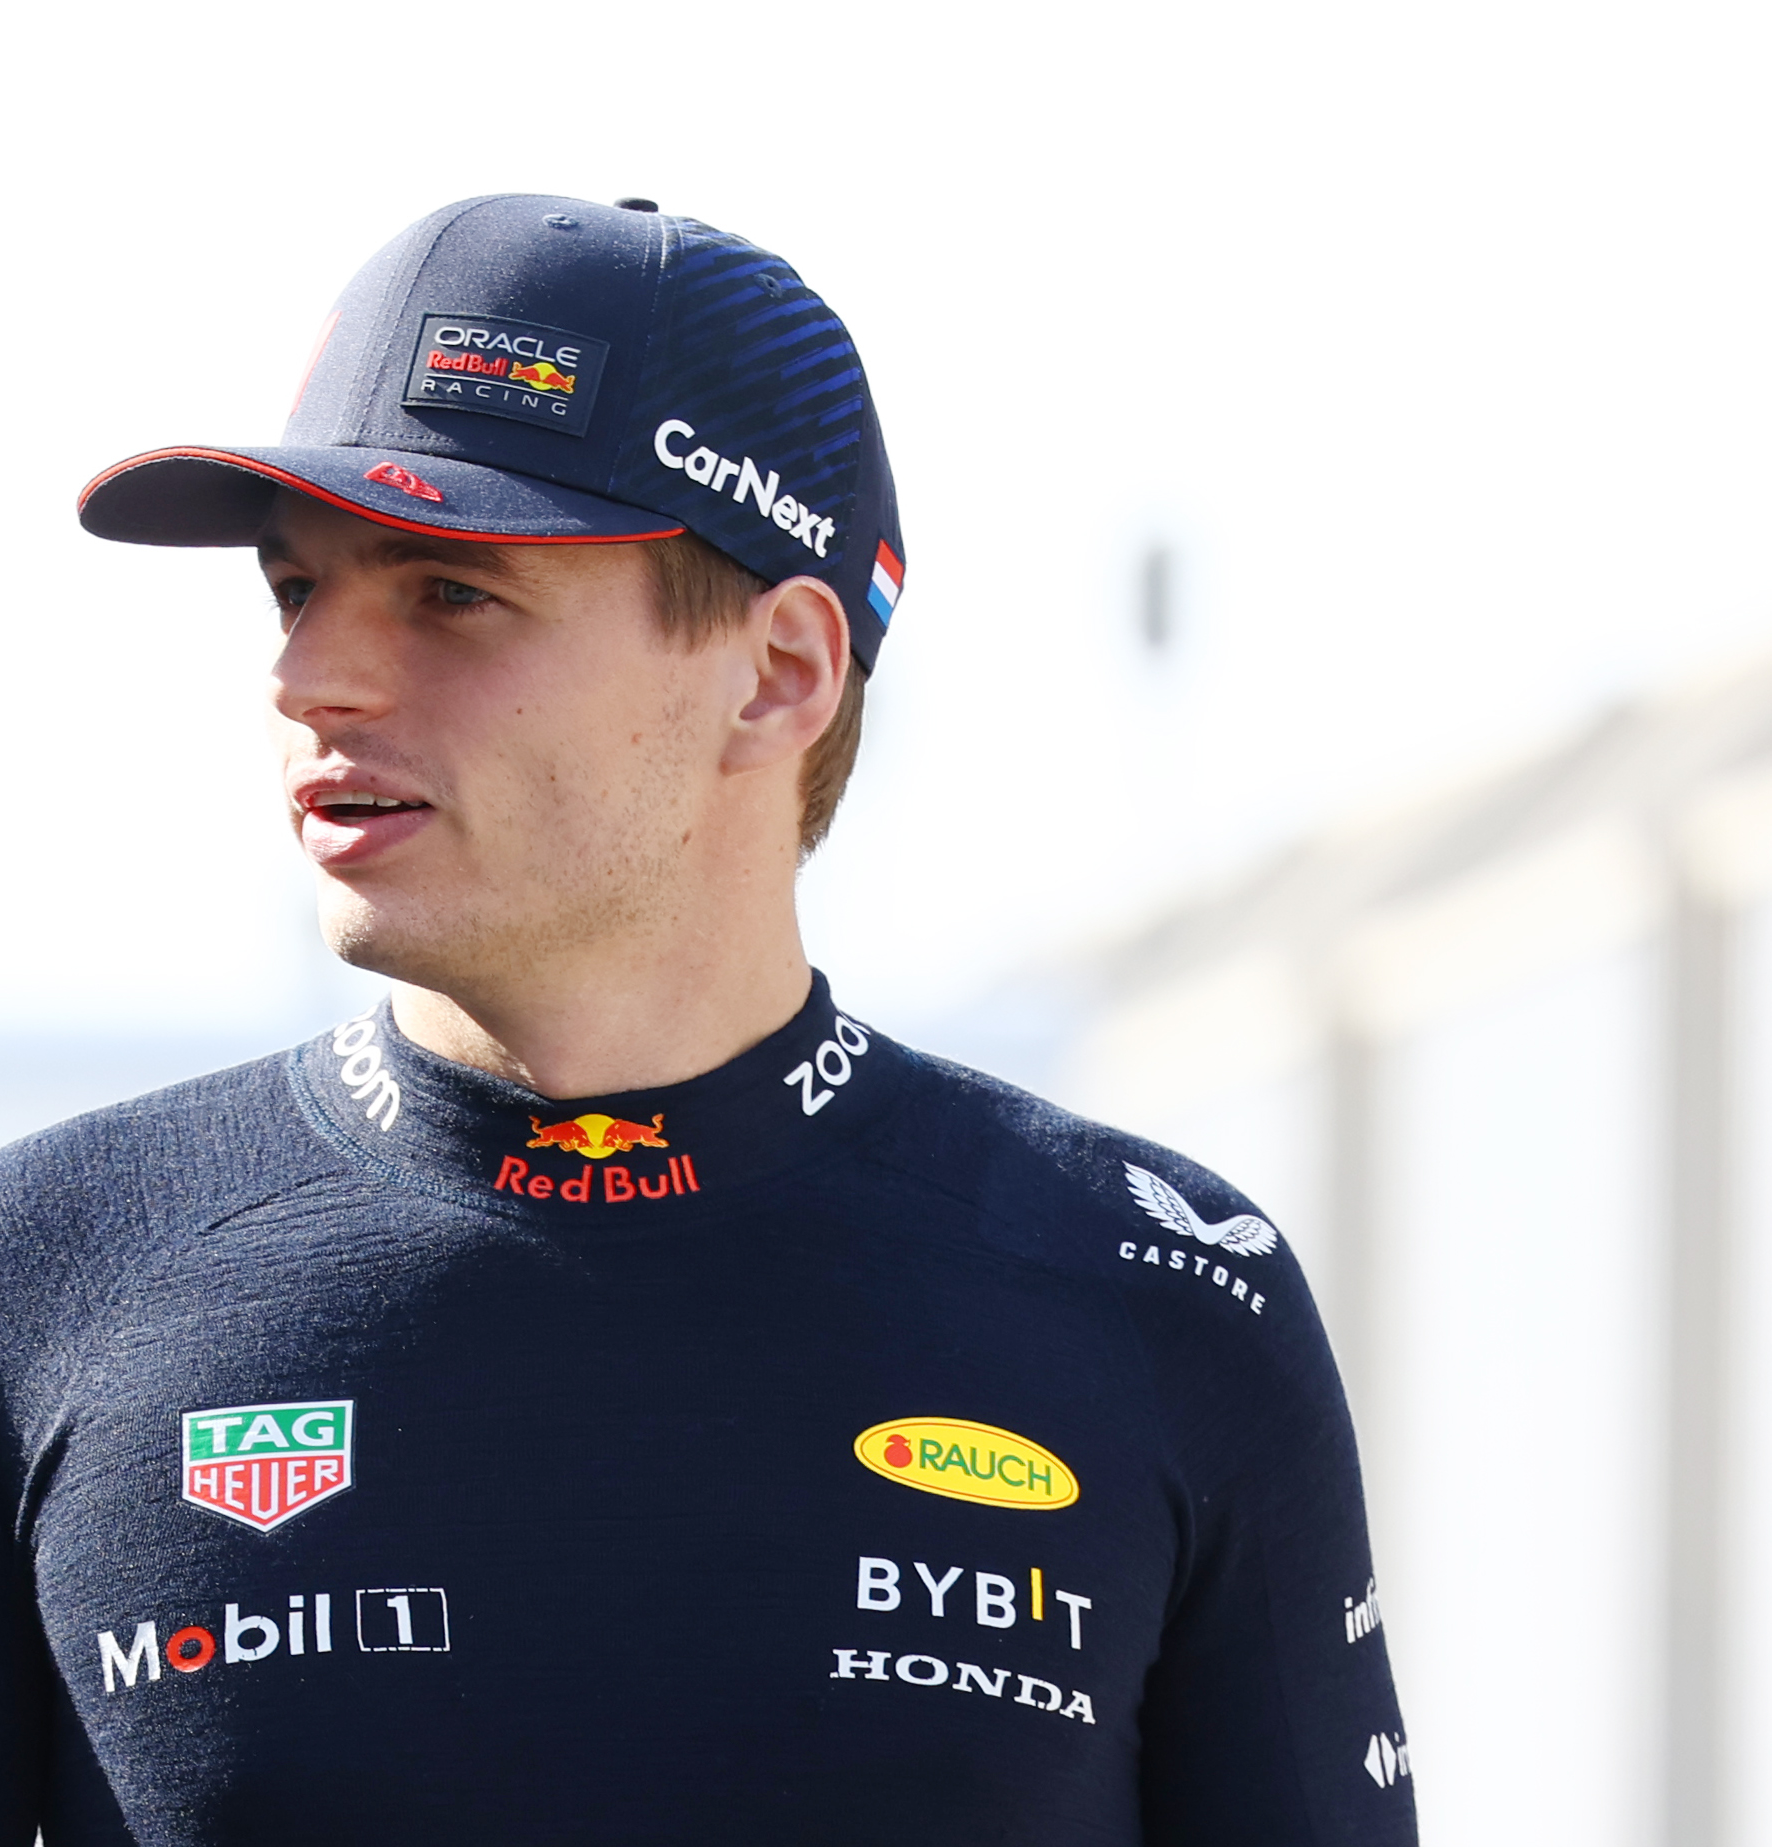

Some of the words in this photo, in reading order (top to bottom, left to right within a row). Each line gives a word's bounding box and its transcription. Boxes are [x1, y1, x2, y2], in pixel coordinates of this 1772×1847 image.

[426, 350, 467, 372] Red
[467, 354, 510, 377] Bull
[434, 326, 581, 368] ORACLE
[421, 379, 567, 416] RACING
[654, 418, 837, 559] CarNext
[333, 1005, 400, 1132] oom
[783, 1010, 871, 1116] zoo
[494, 1155, 593, 1204] Red
[603, 1154, 701, 1203] Bull
[1119, 1241, 1266, 1315] CASTORE
[197, 1409, 337, 1455] TAG
[918, 1438, 1054, 1496] RAUCH
[193, 1454, 341, 1523] HEUER
[855, 1556, 1093, 1650] BYBIT
[97, 1593, 332, 1693] Mobil
[829, 1647, 1097, 1725] HONDA
